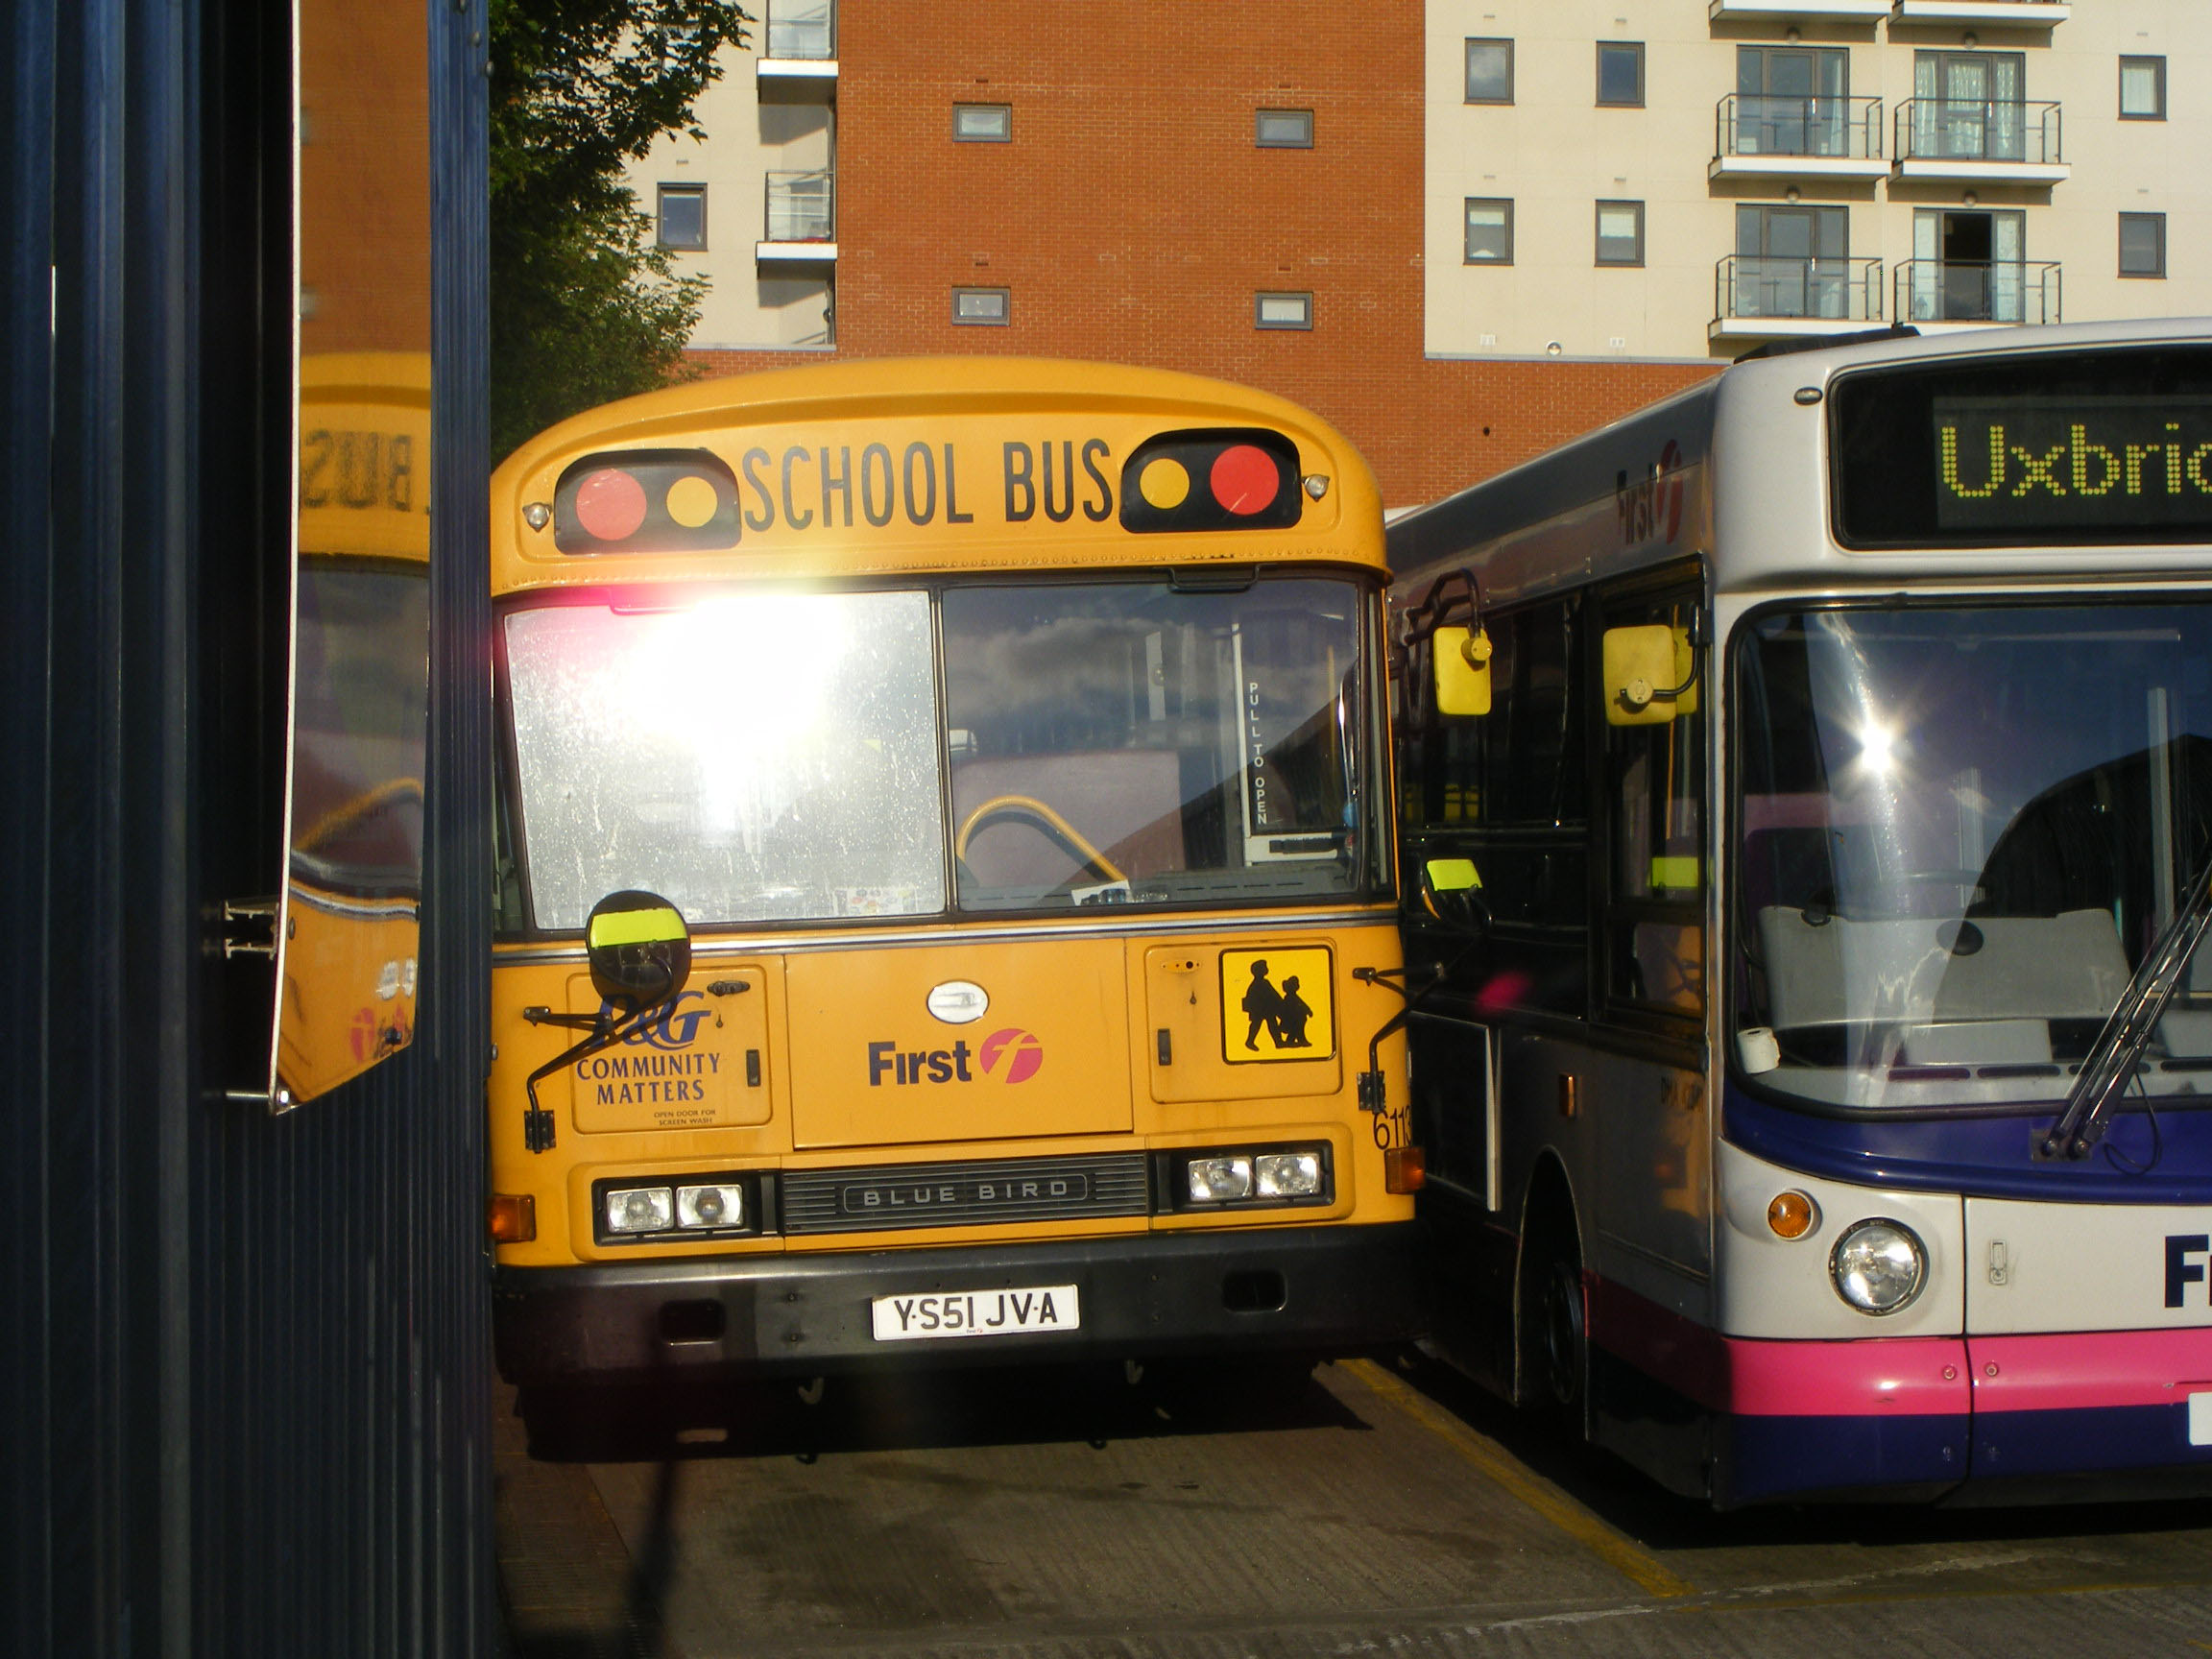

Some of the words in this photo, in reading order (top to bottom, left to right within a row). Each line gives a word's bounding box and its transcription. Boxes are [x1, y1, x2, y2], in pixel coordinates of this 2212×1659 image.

[742, 441, 974, 533] SCHOOL
[1003, 438, 1114, 522] BUS
[1250, 683, 1260, 737] PULL
[1254, 744, 1263, 768] TO
[1255, 777, 1267, 824] OPEN
[592, 991, 711, 1050] &G
[577, 1052, 721, 1080] COMMUNITY
[868, 1040, 972, 1086] First
[597, 1079, 704, 1105] MATTERS
[863, 1186, 954, 1207] BLUE
[977, 1180, 1069, 1200] BIRD
[2165, 1235, 2212, 1308] F
[985, 1292, 1057, 1326] JVA
